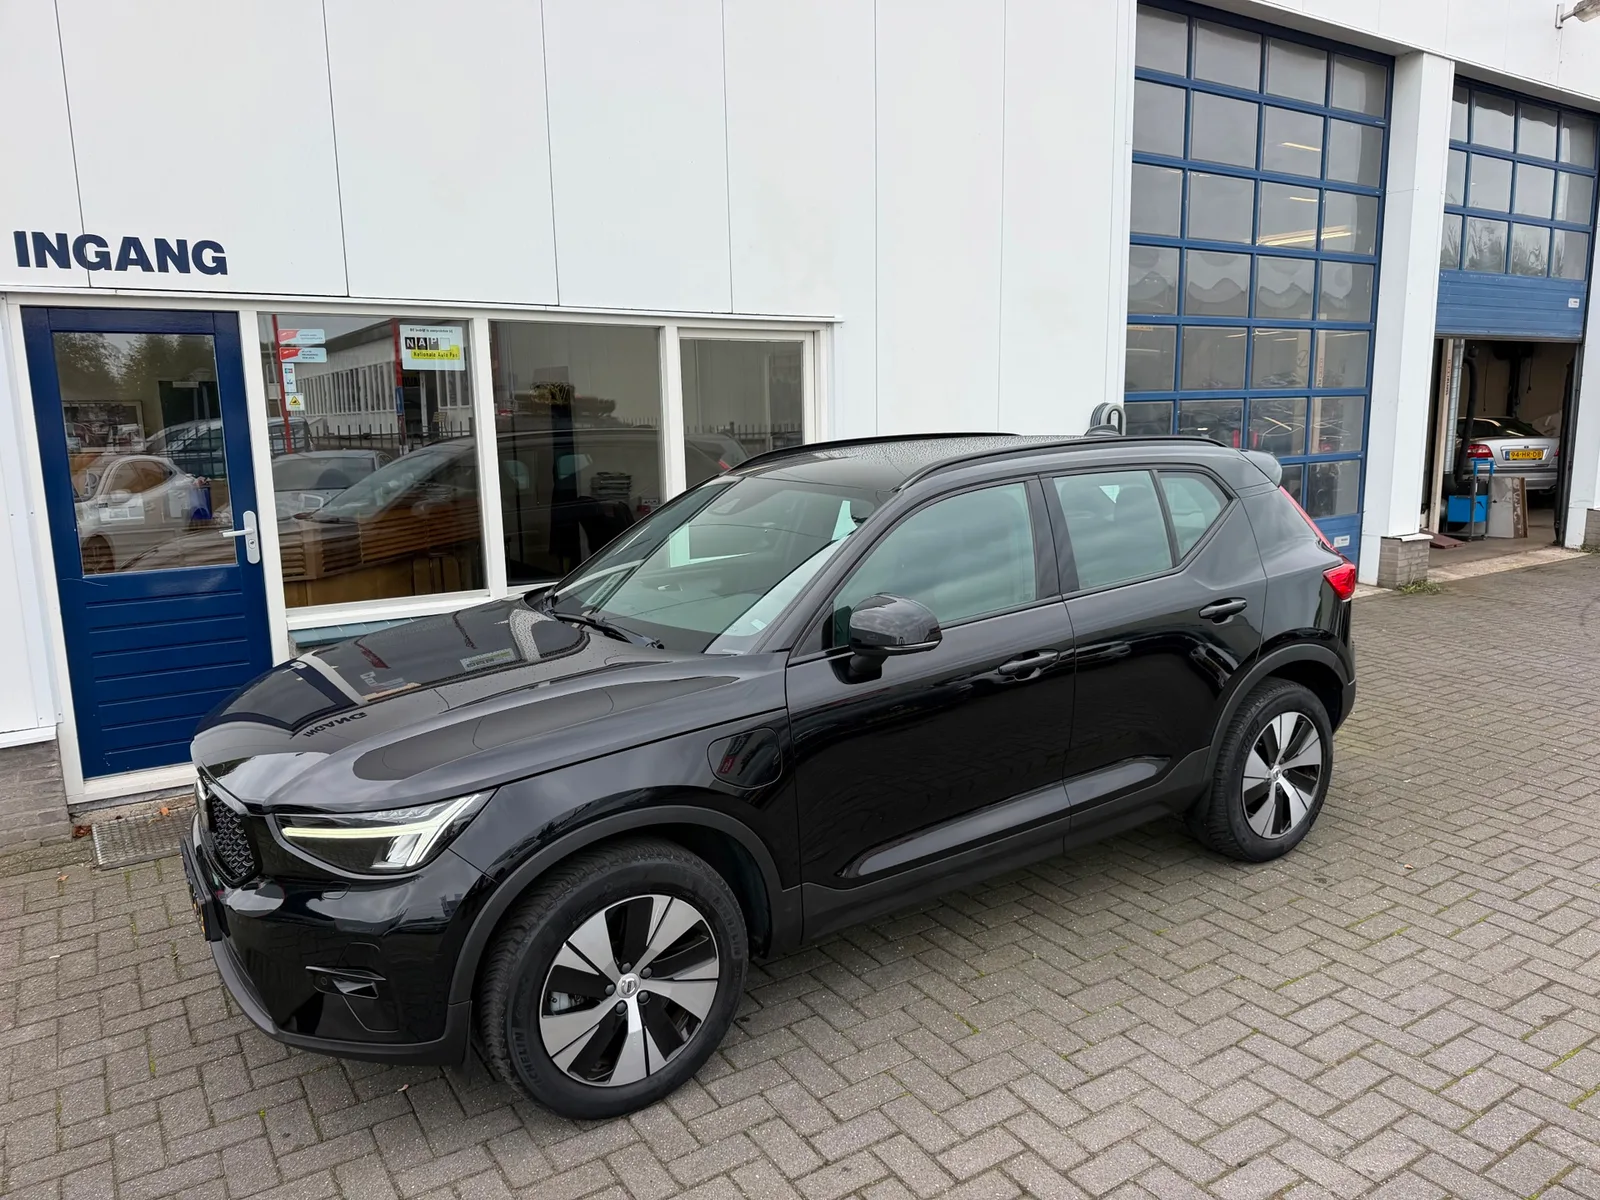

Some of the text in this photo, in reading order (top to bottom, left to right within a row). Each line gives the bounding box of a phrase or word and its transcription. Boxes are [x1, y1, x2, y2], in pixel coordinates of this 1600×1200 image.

[13, 230, 228, 275] INGANG
[406, 337, 438, 348] NAP
[514, 1031, 547, 1092] ICHELIN
